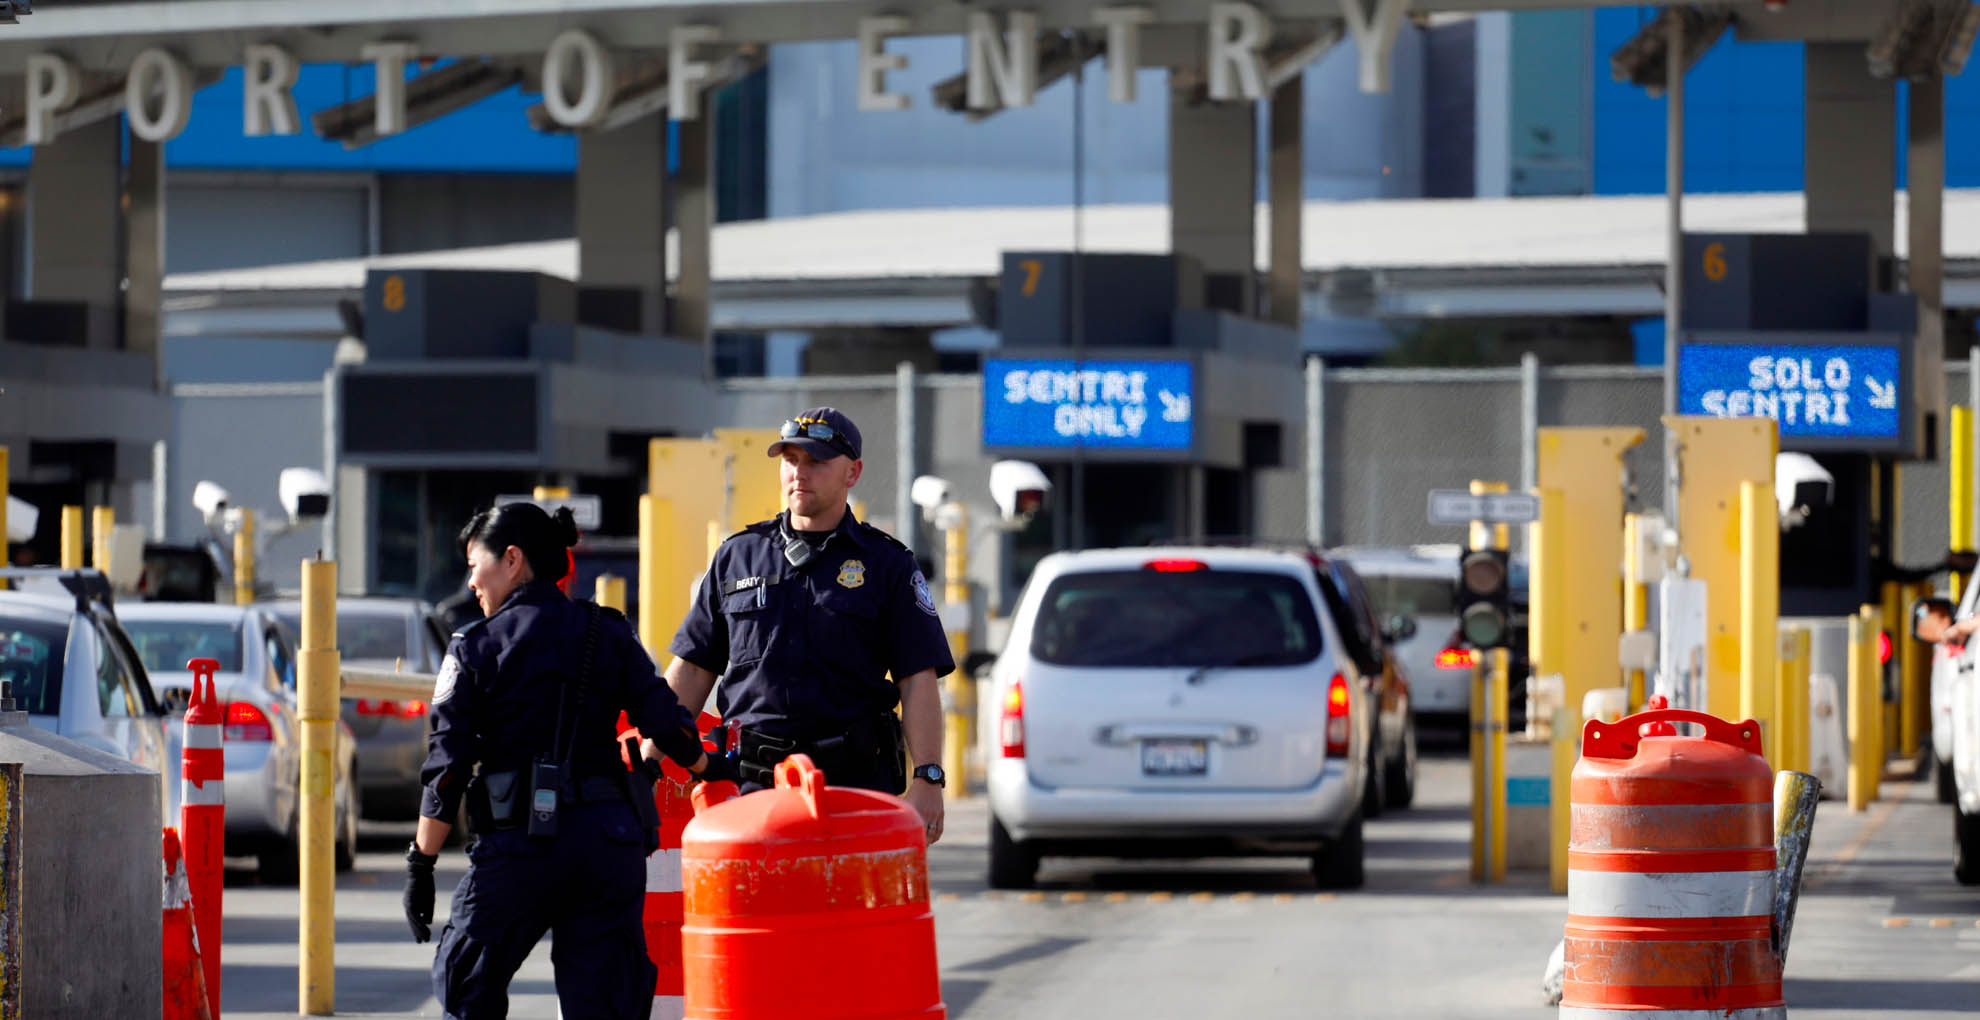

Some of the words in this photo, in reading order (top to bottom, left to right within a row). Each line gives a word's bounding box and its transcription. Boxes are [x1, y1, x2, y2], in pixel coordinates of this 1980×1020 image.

[25, 42, 420, 145] PORT
[541, 27, 722, 128] OF
[857, 0, 1409, 110] ENTRY
[1018, 259, 1043, 297] 7
[1703, 243, 1727, 281] 6
[383, 275, 406, 311] 8
[1003, 369, 1148, 404] SENTRI
[1748, 355, 1851, 391] SOLO
[1054, 402, 1147, 438] ONLY
[1701, 388, 1851, 426] SENTRI
[736, 576, 760, 590] BEATY
